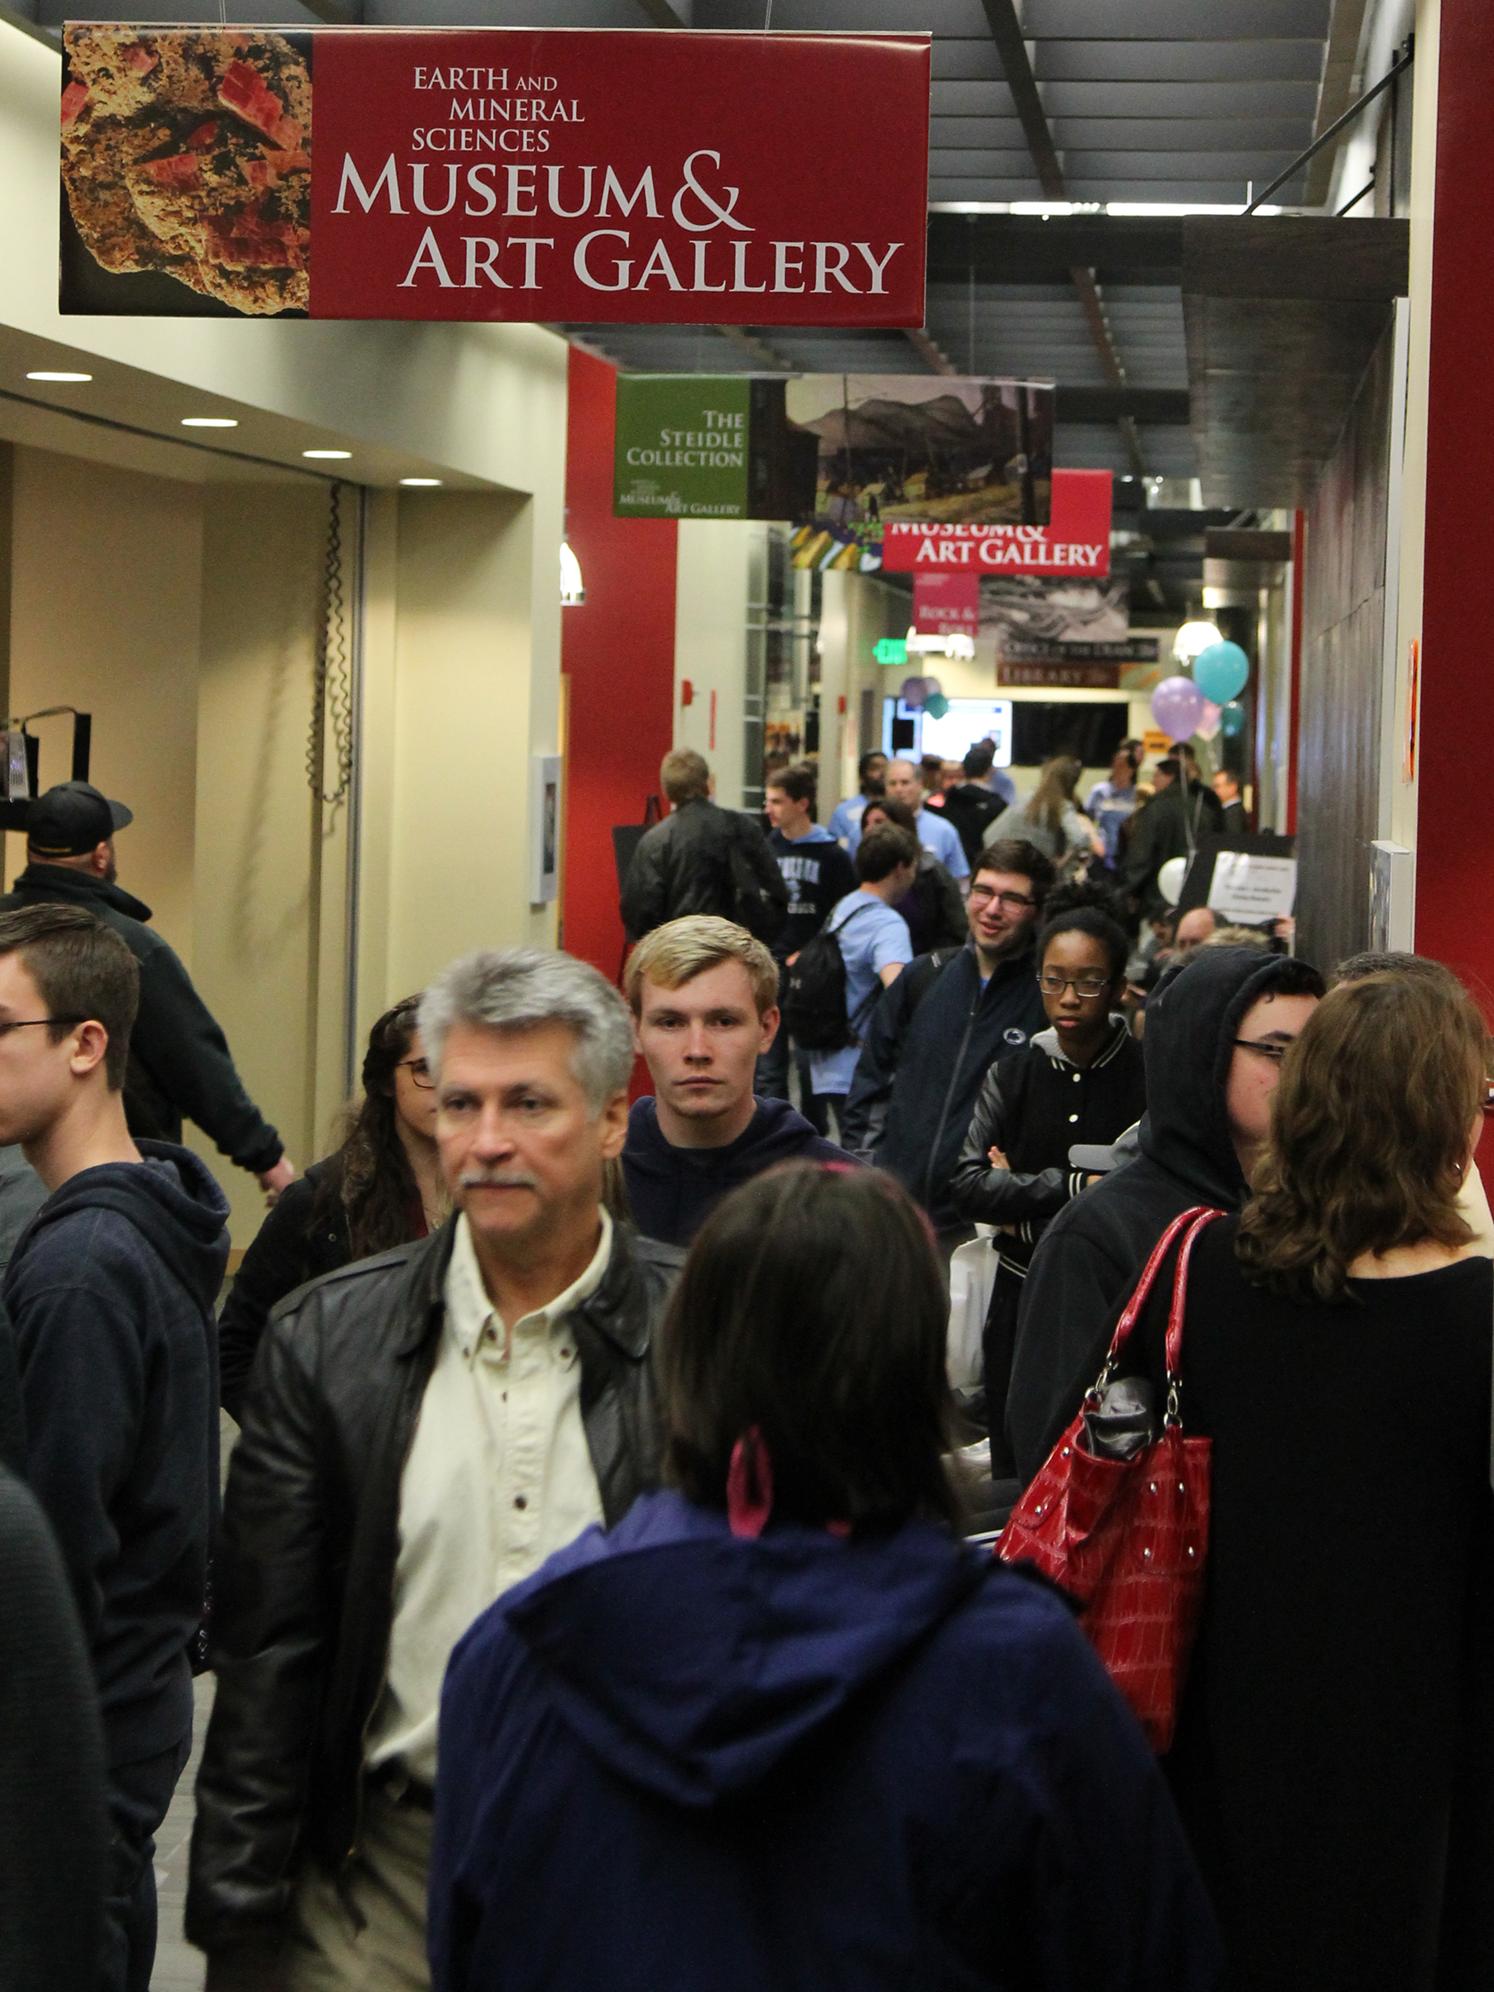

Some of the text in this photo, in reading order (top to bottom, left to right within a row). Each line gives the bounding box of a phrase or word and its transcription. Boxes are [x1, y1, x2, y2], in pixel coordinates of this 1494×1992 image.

[413, 67, 558, 92] EARTH AND
[448, 98, 586, 123] MINERAL
[411, 127, 550, 153] SCIENCES
[397, 226, 904, 295] ART GALLERY
[703, 410, 744, 429] THE
[659, 428, 744, 448] STEIDLE
[626, 447, 744, 468] COLLECTION
[915, 537, 1103, 567] ART GALLERY
